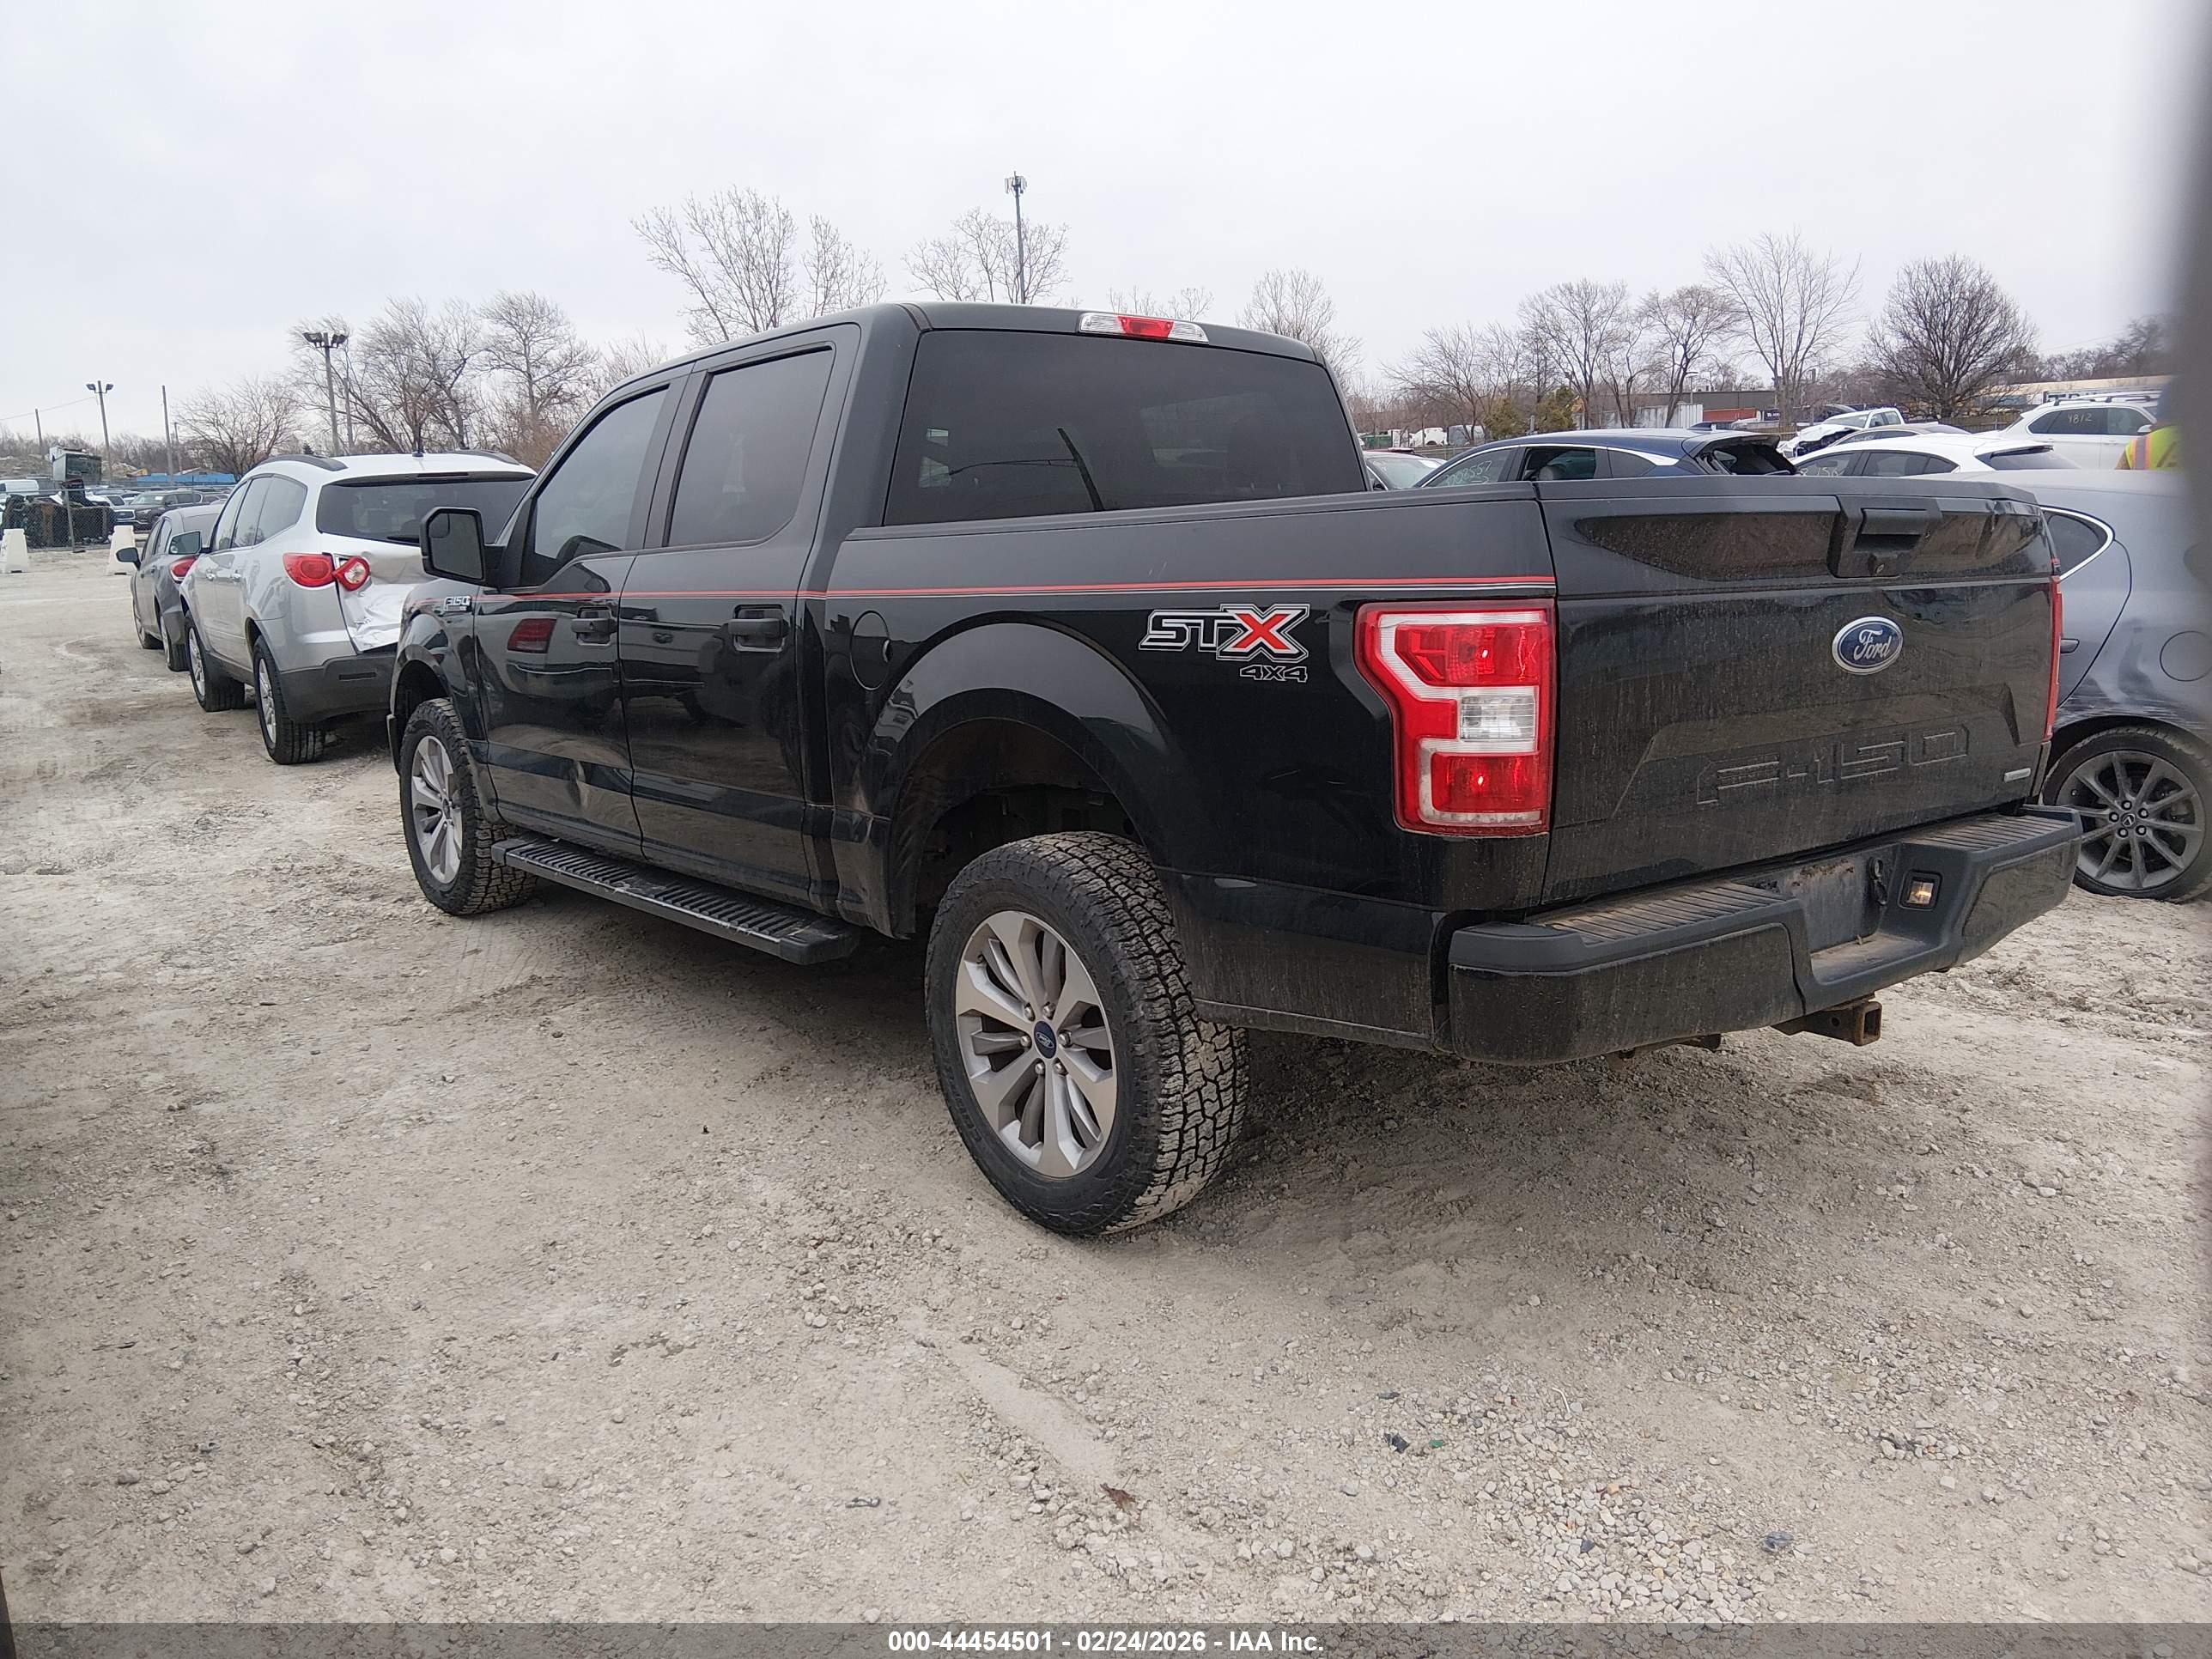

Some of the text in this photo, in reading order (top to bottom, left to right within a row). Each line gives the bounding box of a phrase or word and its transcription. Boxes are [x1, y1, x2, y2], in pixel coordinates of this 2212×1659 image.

[2068, 413, 2094, 423] 4812
[1139, 604, 1310, 663] STX
[1853, 629, 1893, 660] Ford
[1696, 724, 1969, 805] F-150
